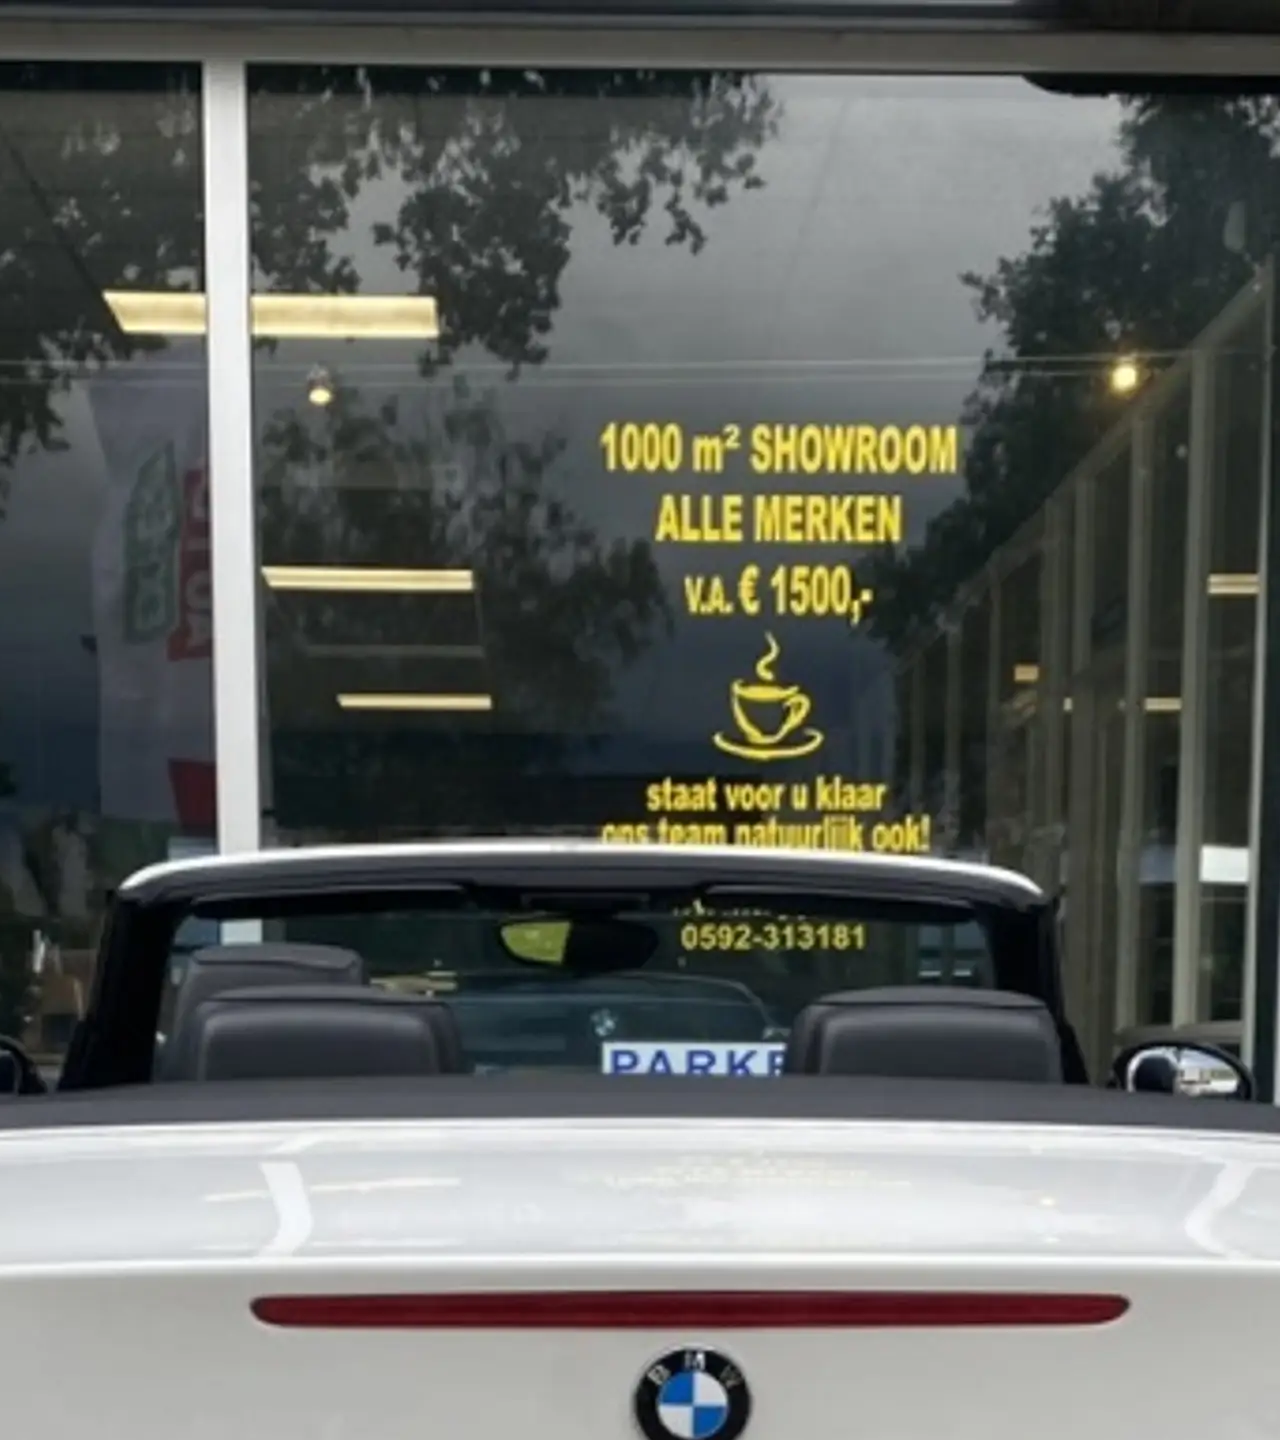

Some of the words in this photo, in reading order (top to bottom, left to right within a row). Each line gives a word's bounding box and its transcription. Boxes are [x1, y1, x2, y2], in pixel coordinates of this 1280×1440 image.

[600, 422, 684, 473] 1000
[692, 424, 742, 473] m²
[750, 425, 958, 474] SHOWROOM
[655, 495, 744, 543] ALLE
[755, 495, 903, 543] MERKEN
[738, 565, 760, 615] €
[770, 565, 874, 626] 1500,-
[647, 777, 718, 811] staat
[725, 783, 784, 811] voor
[793, 783, 808, 811] u
[816, 777, 887, 812] klaar
[659, 817, 727, 846] team
[735, 816, 864, 852] natuurlijk
[872, 815, 931, 851] ook!
[680, 923, 867, 951] 0592-313181
